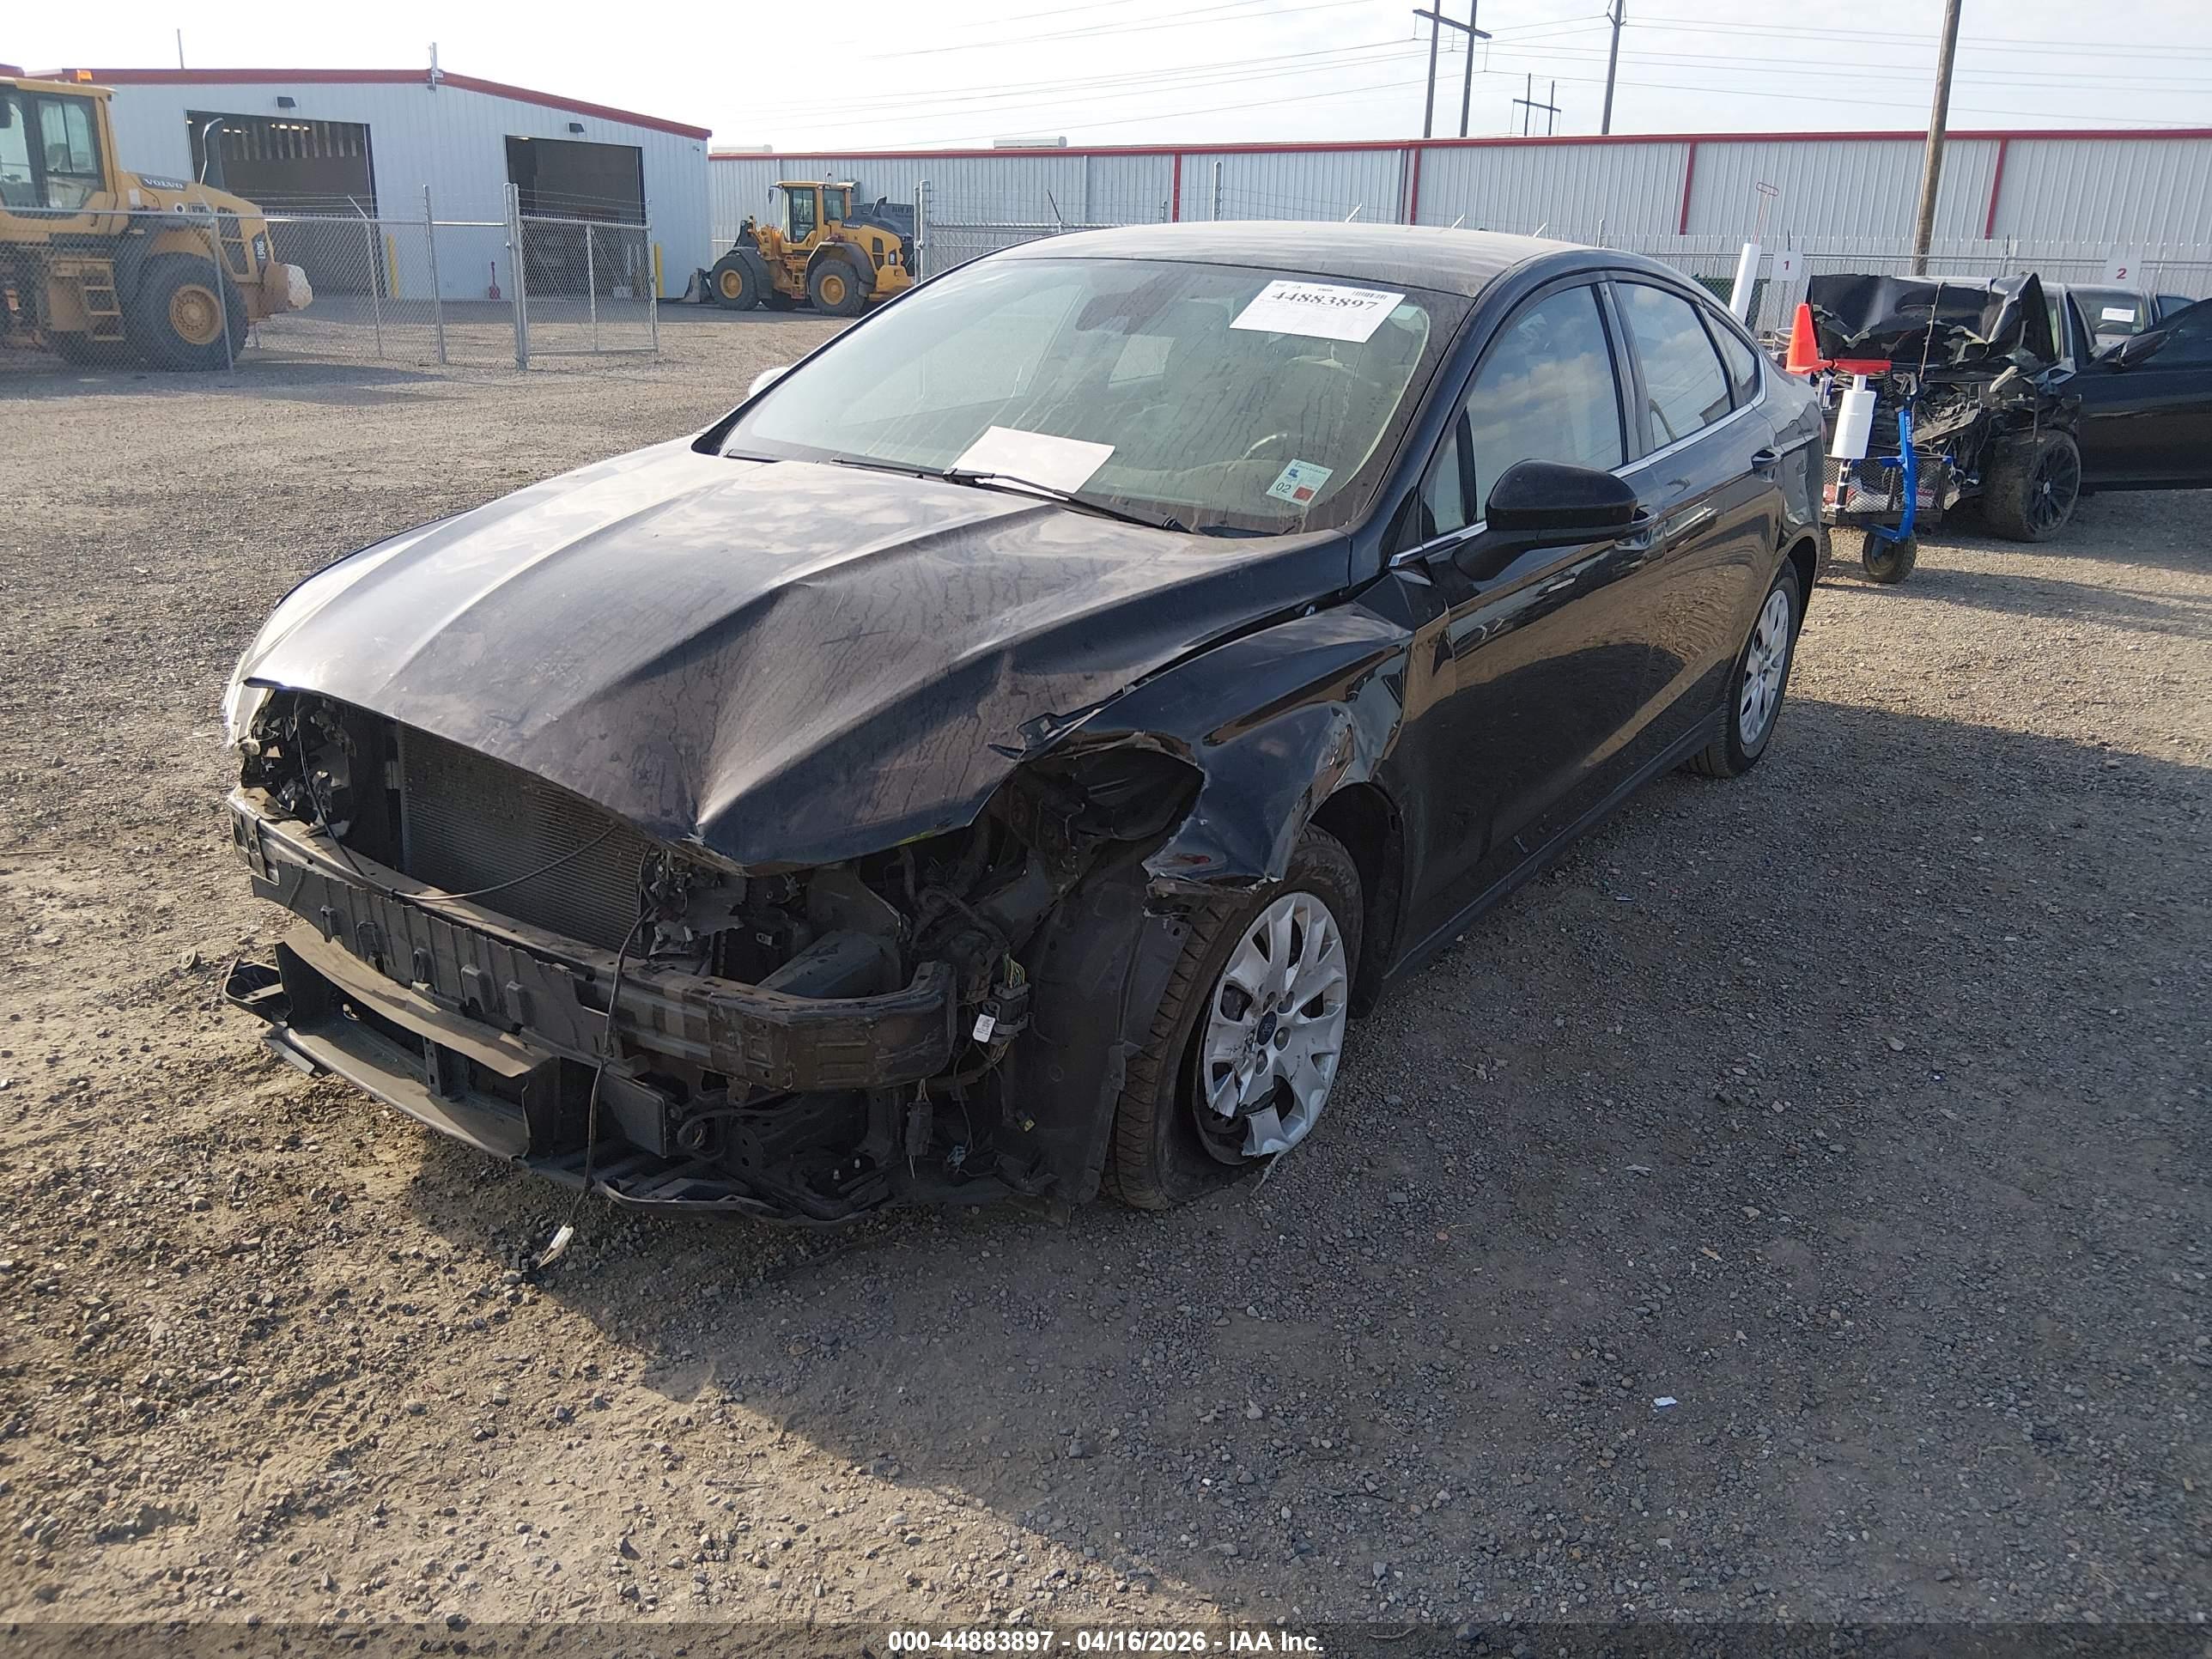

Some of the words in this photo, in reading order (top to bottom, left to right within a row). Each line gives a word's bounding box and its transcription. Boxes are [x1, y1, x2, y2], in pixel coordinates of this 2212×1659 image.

[143, 178, 184, 189] VOLVO
[1784, 260, 1790, 270] 1
[2116, 268, 2127, 279] 2
[1272, 291, 1378, 311] 44883897
[1276, 482, 1291, 494] 02
